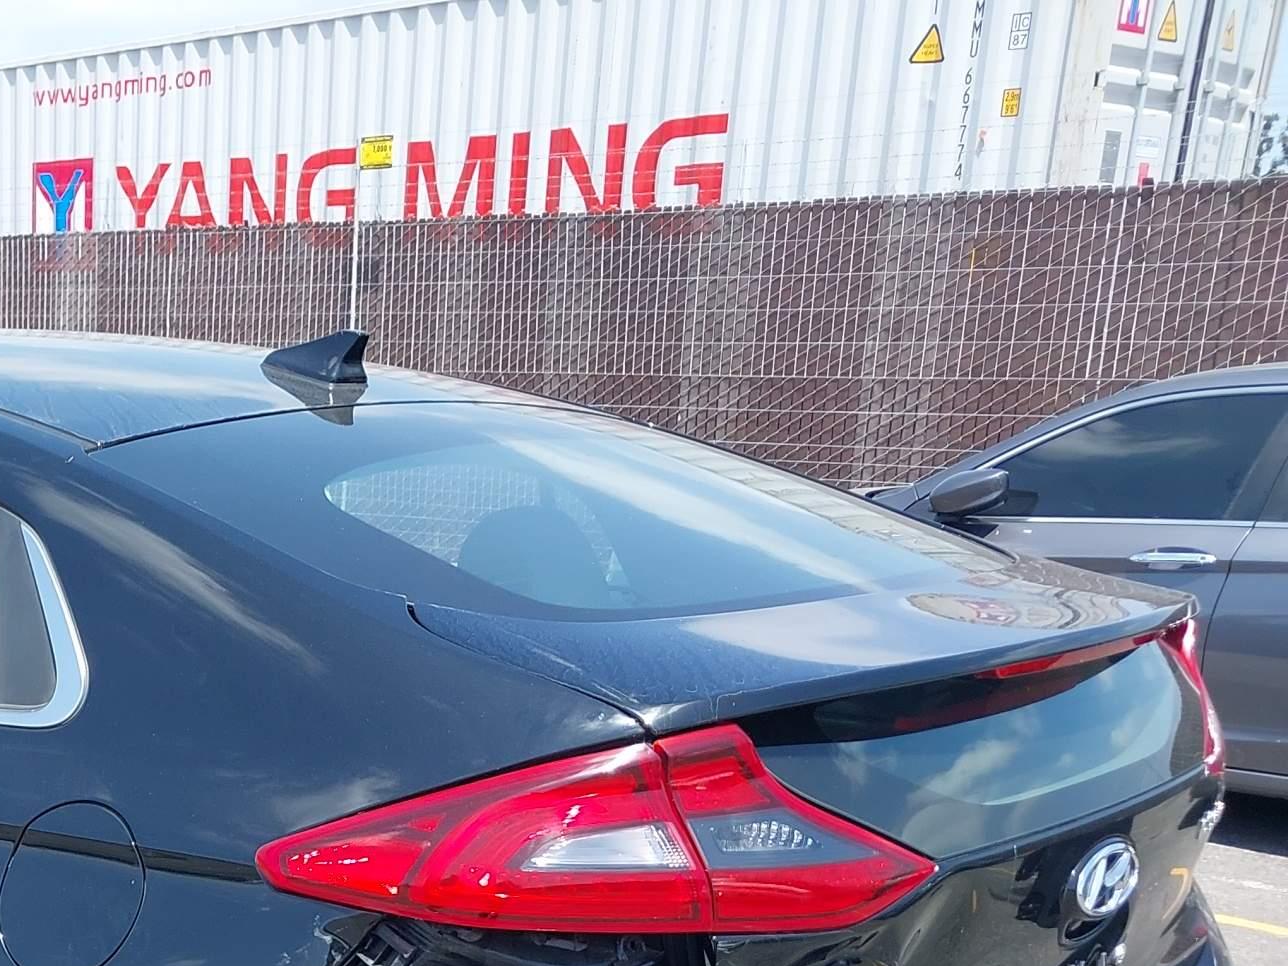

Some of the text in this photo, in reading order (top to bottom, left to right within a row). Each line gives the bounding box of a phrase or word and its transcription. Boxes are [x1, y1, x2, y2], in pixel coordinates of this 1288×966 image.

[1012, 33, 1027, 46] 87
[115, 113, 730, 229] YANG MING
[954, 67, 973, 181] 667774
